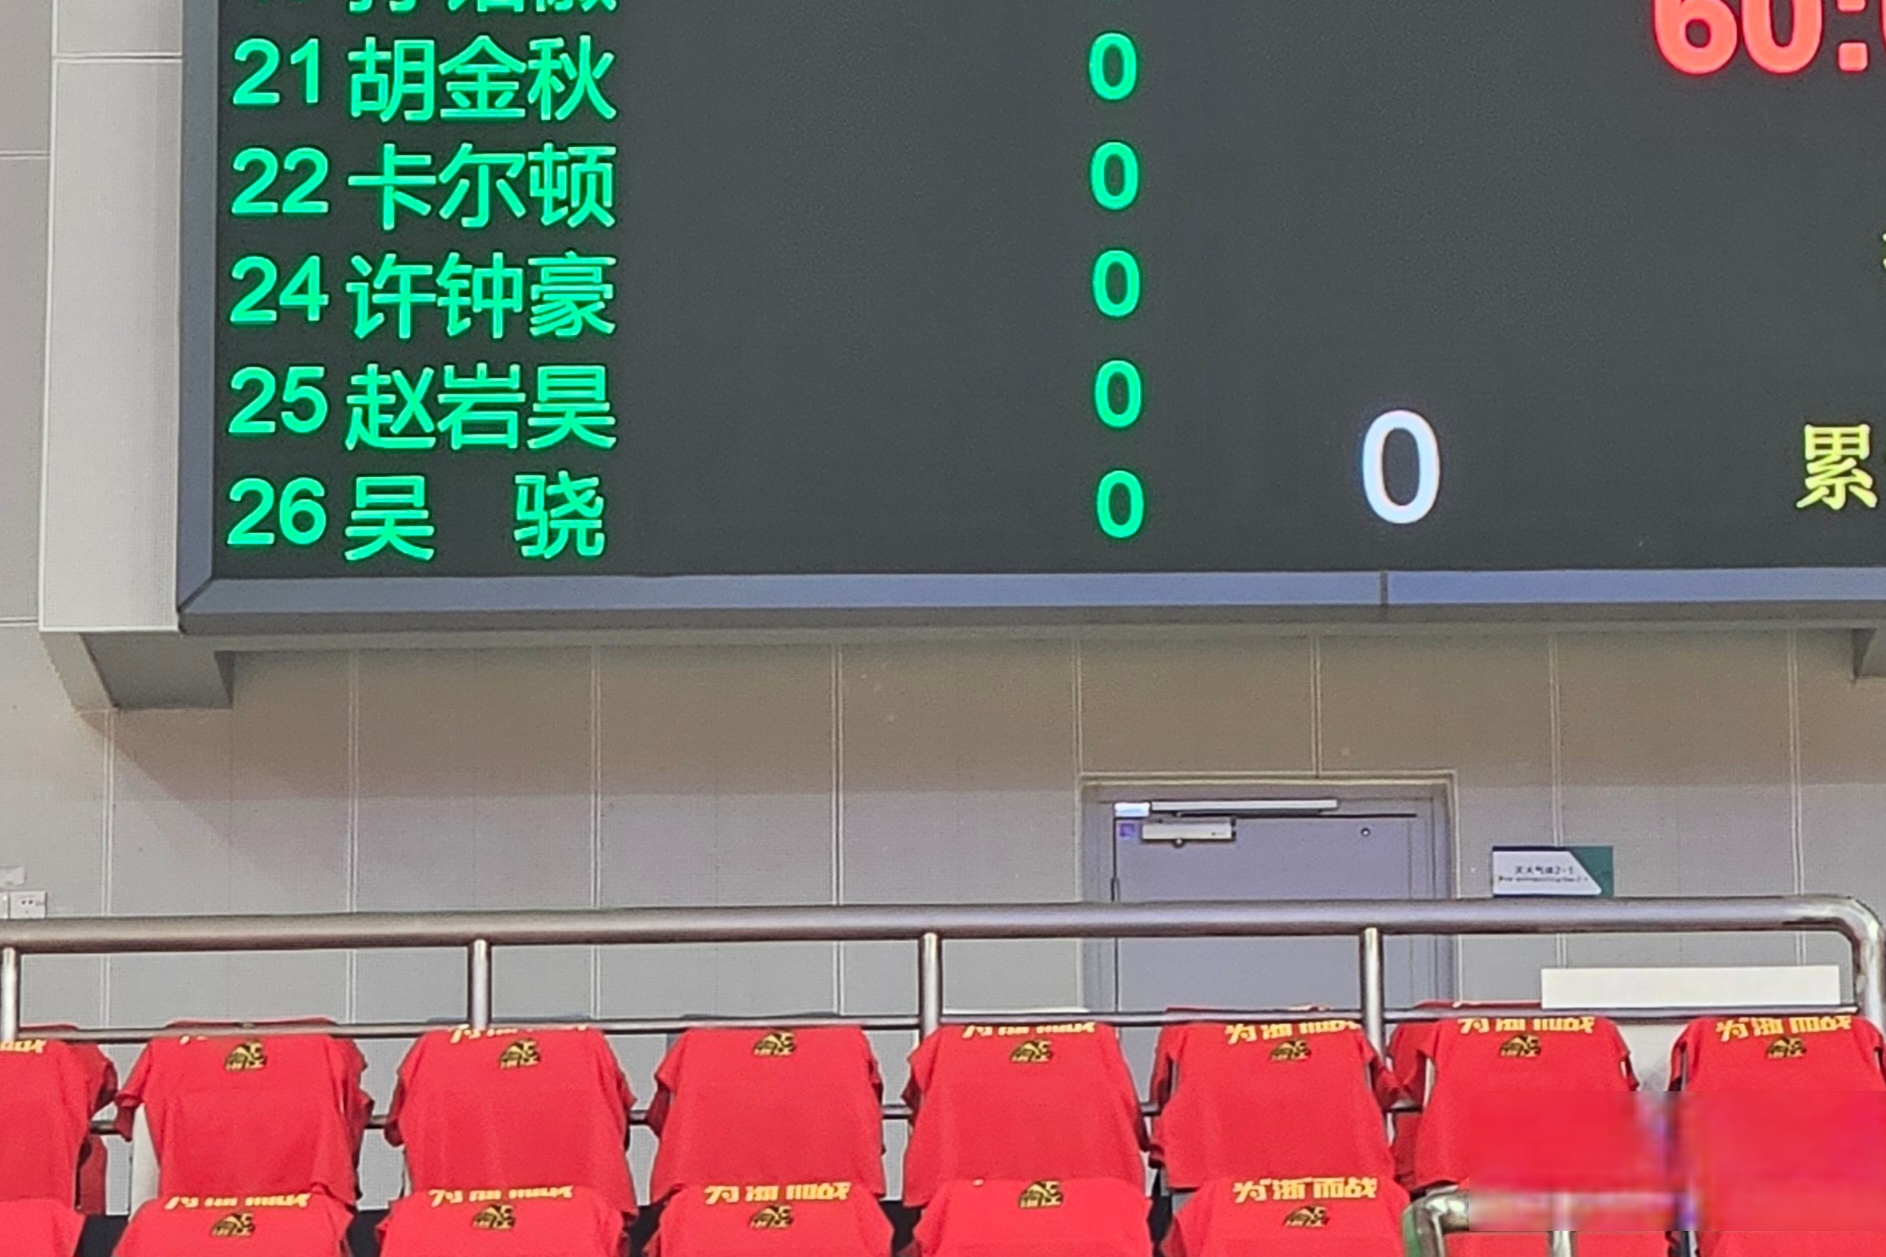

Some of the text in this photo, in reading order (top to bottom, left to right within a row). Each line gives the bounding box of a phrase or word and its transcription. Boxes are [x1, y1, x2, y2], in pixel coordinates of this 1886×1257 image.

[230, 30, 1139, 125] 21 胡金秋 0
[229, 139, 1141, 233] 22 卡尔顿 0
[227, 248, 1142, 341] 24 许钟豪 0
[226, 358, 1144, 453] 25 赵岩昊 0
[224, 475, 329, 547] 26
[1094, 468, 1147, 540] 0
[1359, 407, 1442, 526] 0
